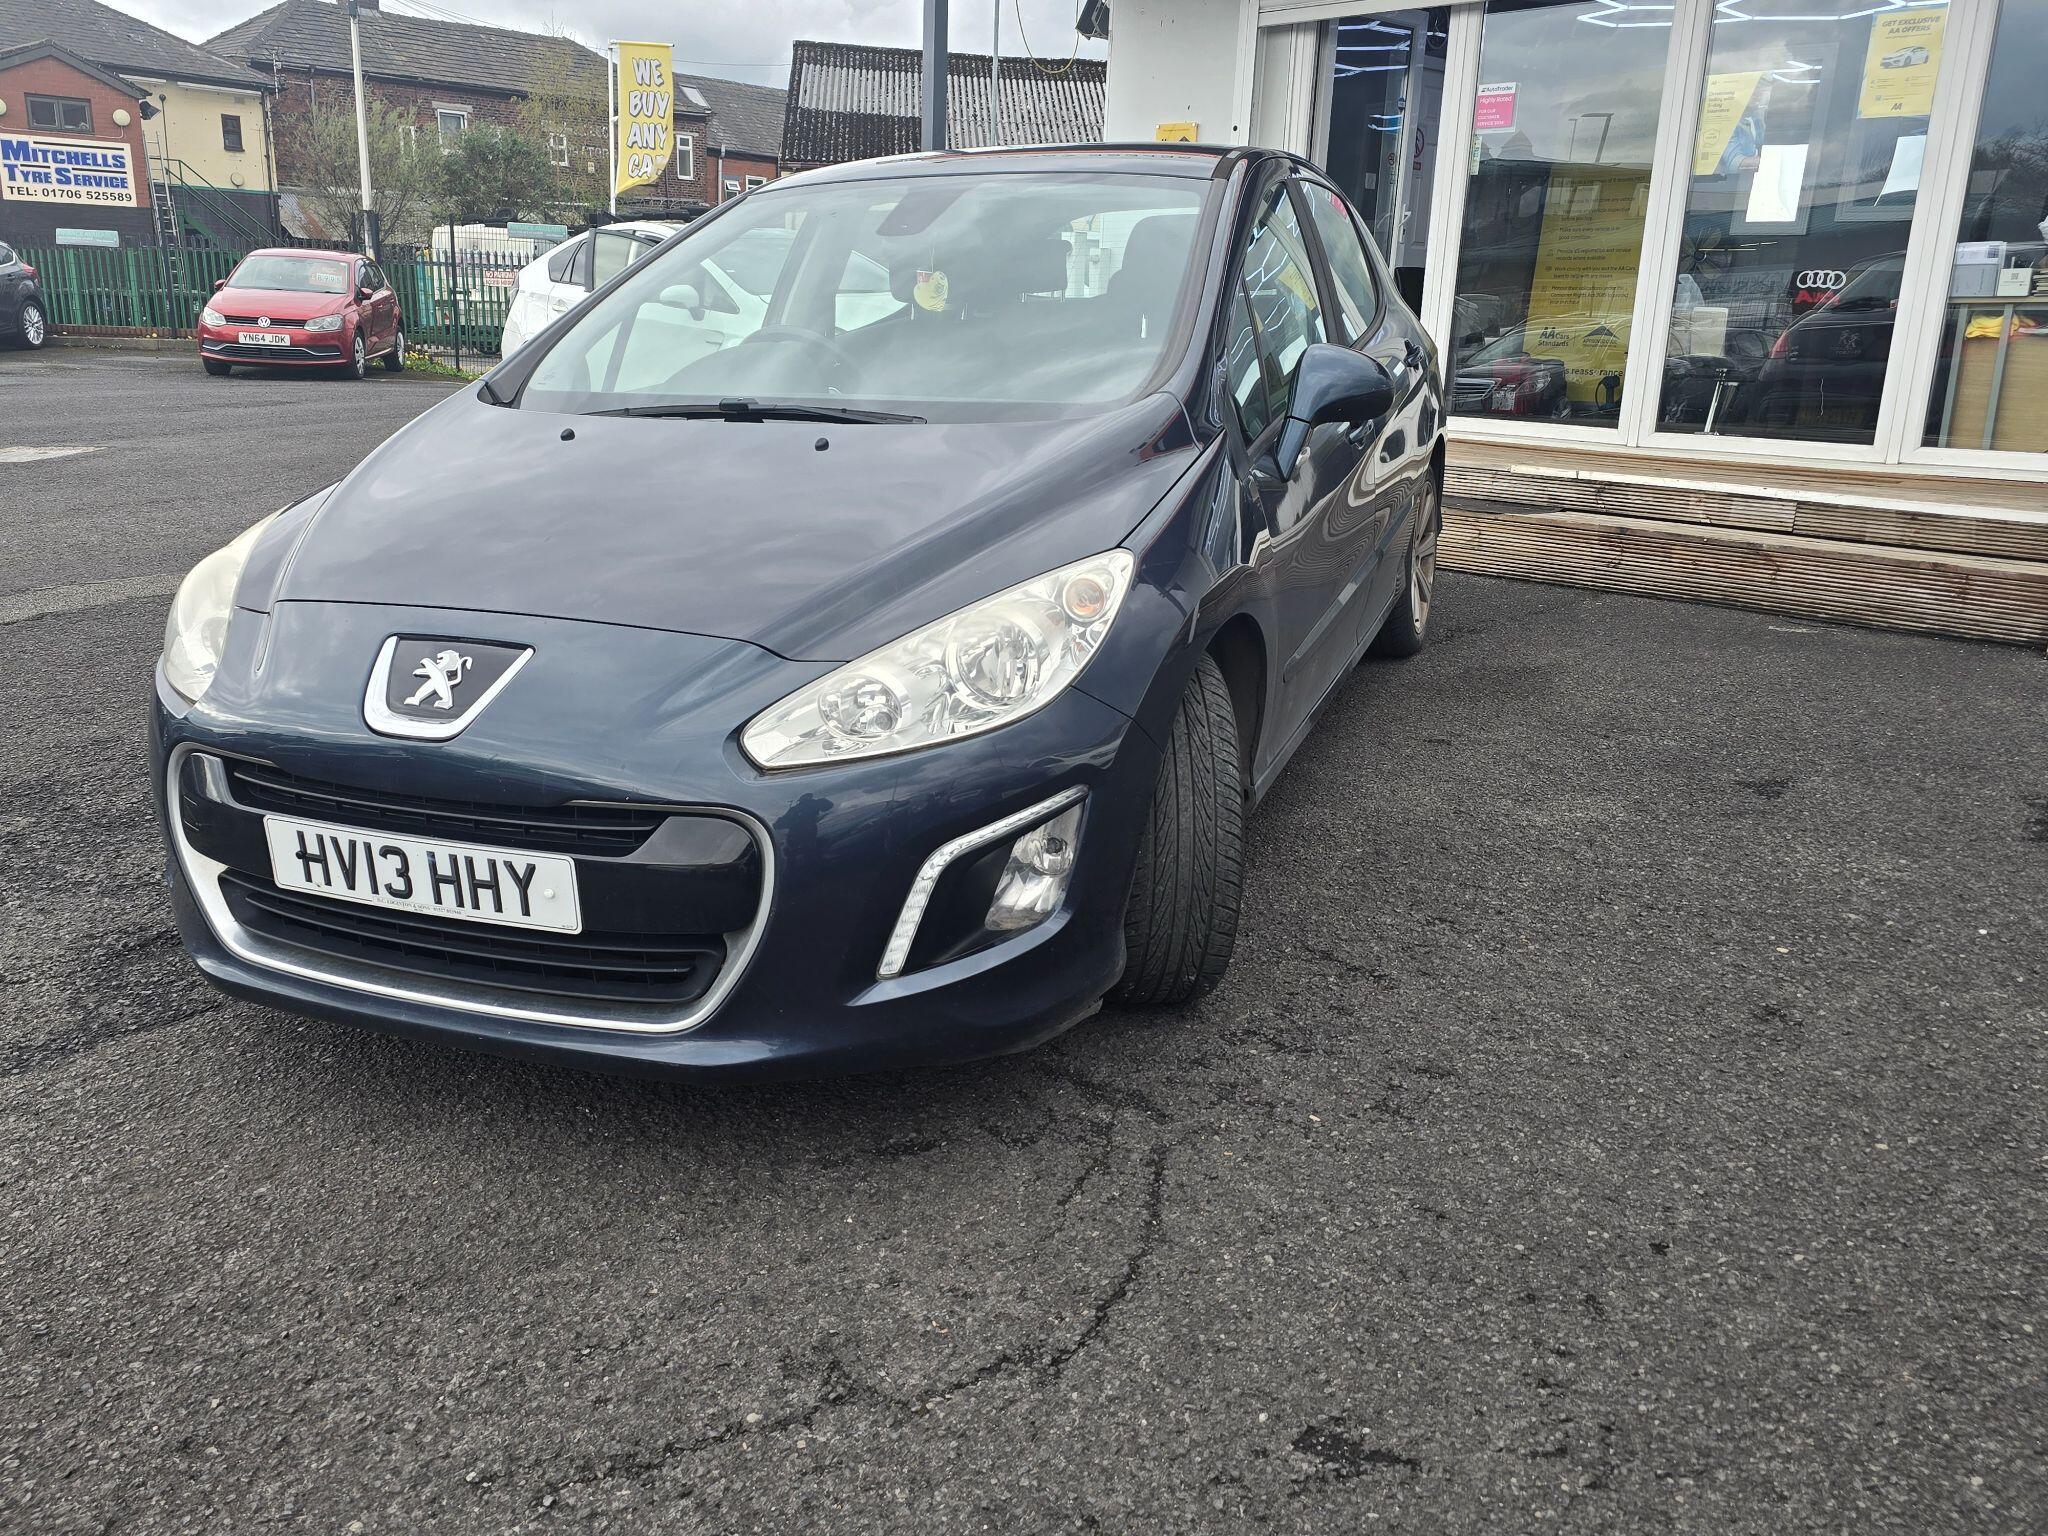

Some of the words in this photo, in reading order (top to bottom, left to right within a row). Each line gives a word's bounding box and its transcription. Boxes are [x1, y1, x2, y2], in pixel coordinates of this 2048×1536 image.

[1898, 16, 1940, 25] EXCLUSIVE
[1902, 25, 1930, 33] OFFERS
[632, 57, 664, 86] WE
[629, 90, 670, 119] BUY
[626, 122, 668, 150] ANY
[4, 164, 52, 184] TYRE
[55, 167, 128, 188] SERVICE
[8, 186, 37, 196] TEL:
[42, 188, 81, 198] 01706
[87, 191, 132, 201] 525589
[244, 334, 265, 342] YN64
[269, 335, 286, 343] JDK
[296, 830, 413, 900] HV13
[426, 850, 536, 916] HHY
